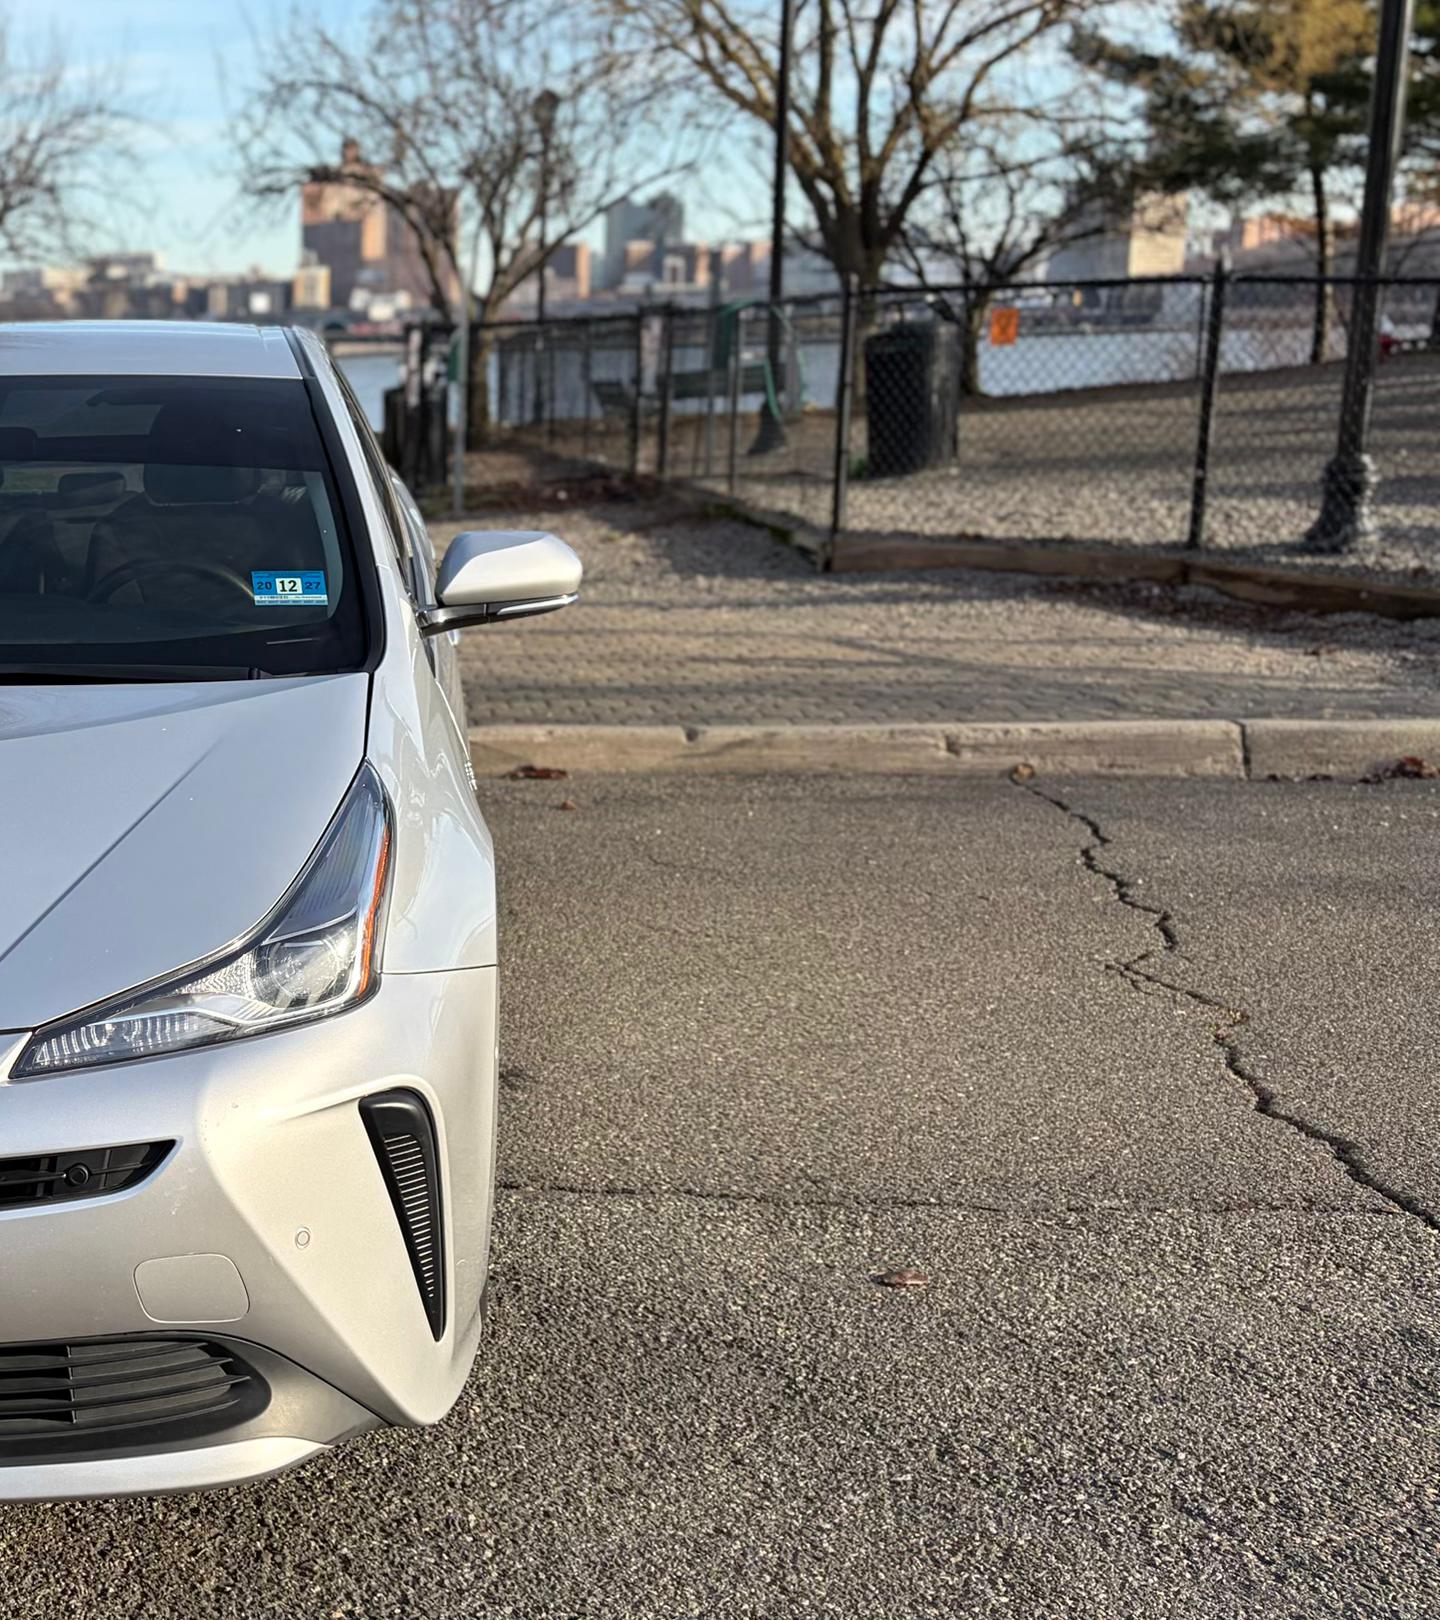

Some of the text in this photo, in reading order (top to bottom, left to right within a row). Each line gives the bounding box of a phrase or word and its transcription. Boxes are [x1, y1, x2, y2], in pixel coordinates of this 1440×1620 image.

[257, 580, 321, 592] 20 12 27
